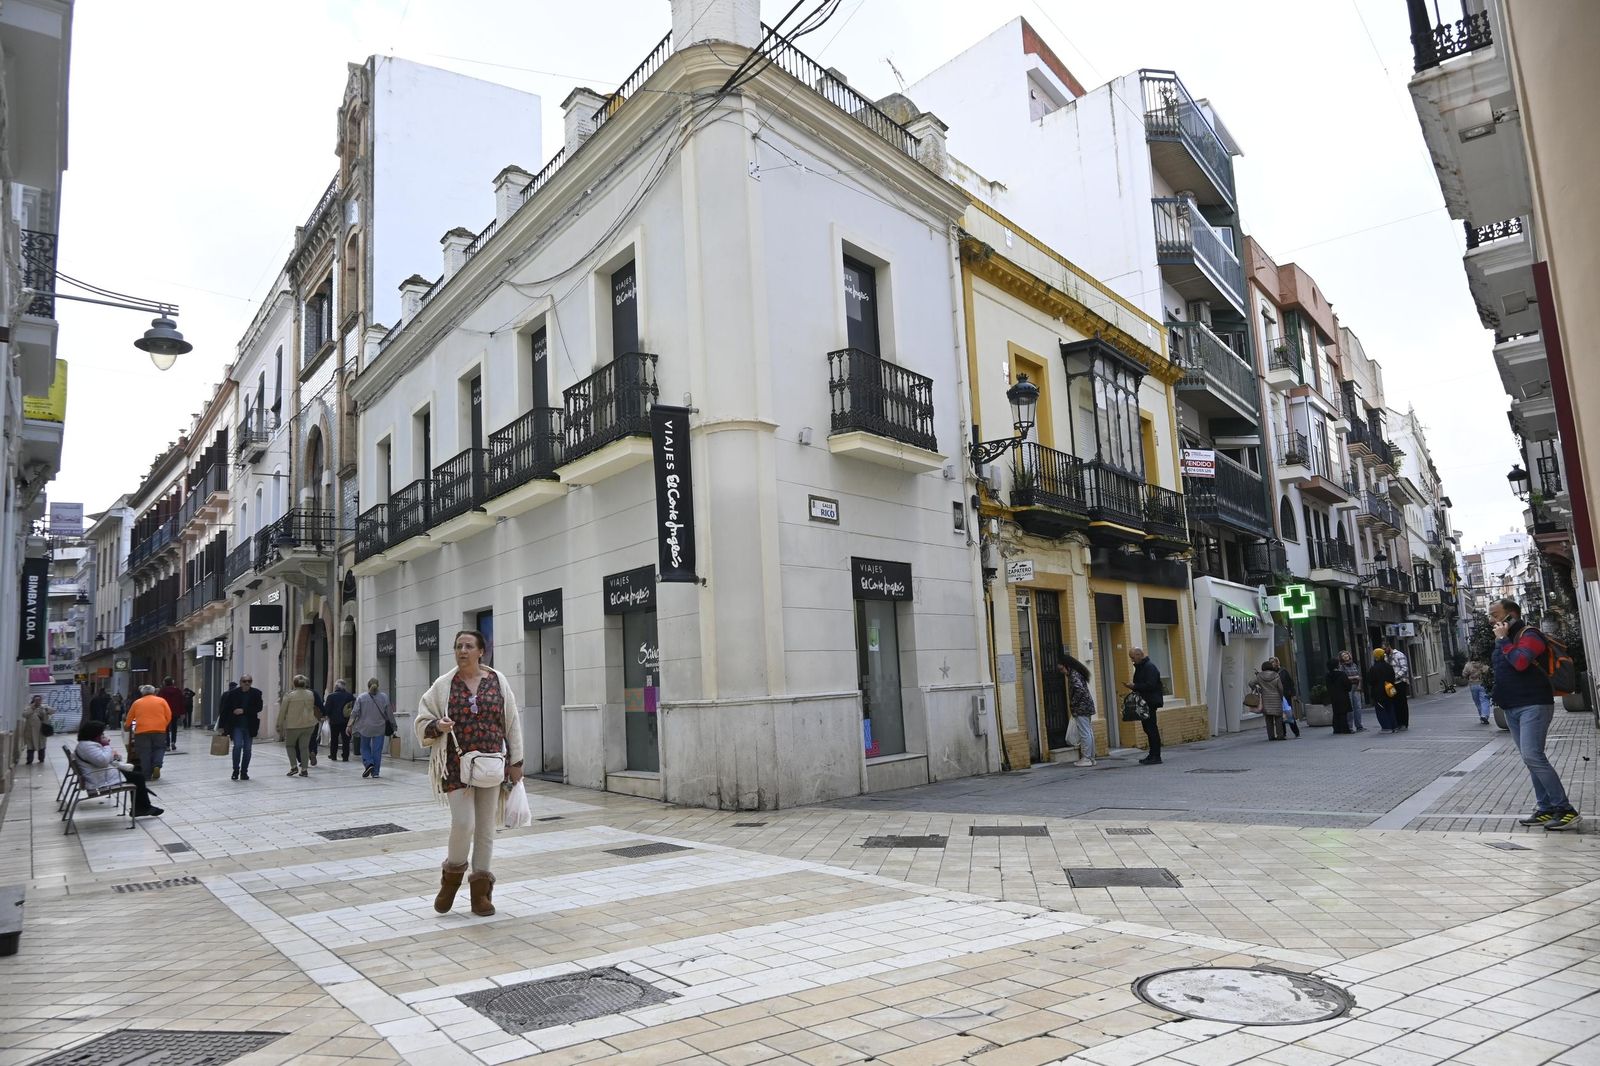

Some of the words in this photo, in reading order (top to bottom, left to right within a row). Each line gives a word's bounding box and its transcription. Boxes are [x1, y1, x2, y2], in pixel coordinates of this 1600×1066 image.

[616, 276, 632, 291] VIAJES
[663, 420, 675, 470] VIAJES
[666, 475, 680, 488] El
[667, 487, 680, 520] Corte
[821, 508, 835, 518] RICO
[665, 521, 684, 568] Inglés
[860, 563, 883, 574] VIAJES
[1008, 567, 1031, 575] ZAPATERO
[610, 576, 629, 587] VIAJES
[28, 575, 39, 606] BIMBA
[26, 616, 36, 641] LOLA
